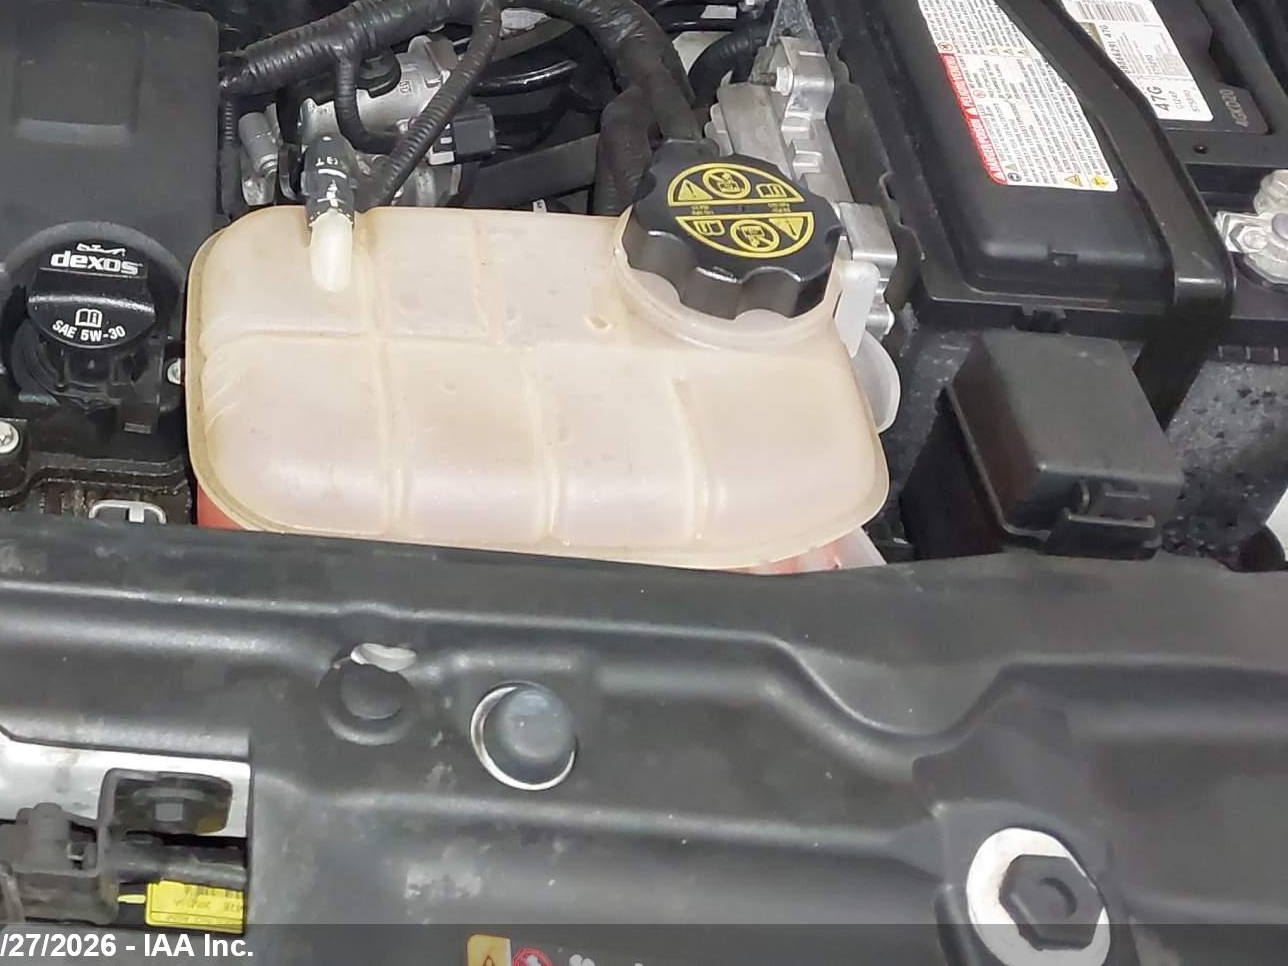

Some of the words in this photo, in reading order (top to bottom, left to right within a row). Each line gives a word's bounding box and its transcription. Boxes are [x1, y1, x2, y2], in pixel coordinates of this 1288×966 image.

[1146, 86, 1170, 112] 47G
[50, 250, 140, 276] dexos
[52, 319, 76, 339] SAE
[80, 325, 126, 342] 5W-30
